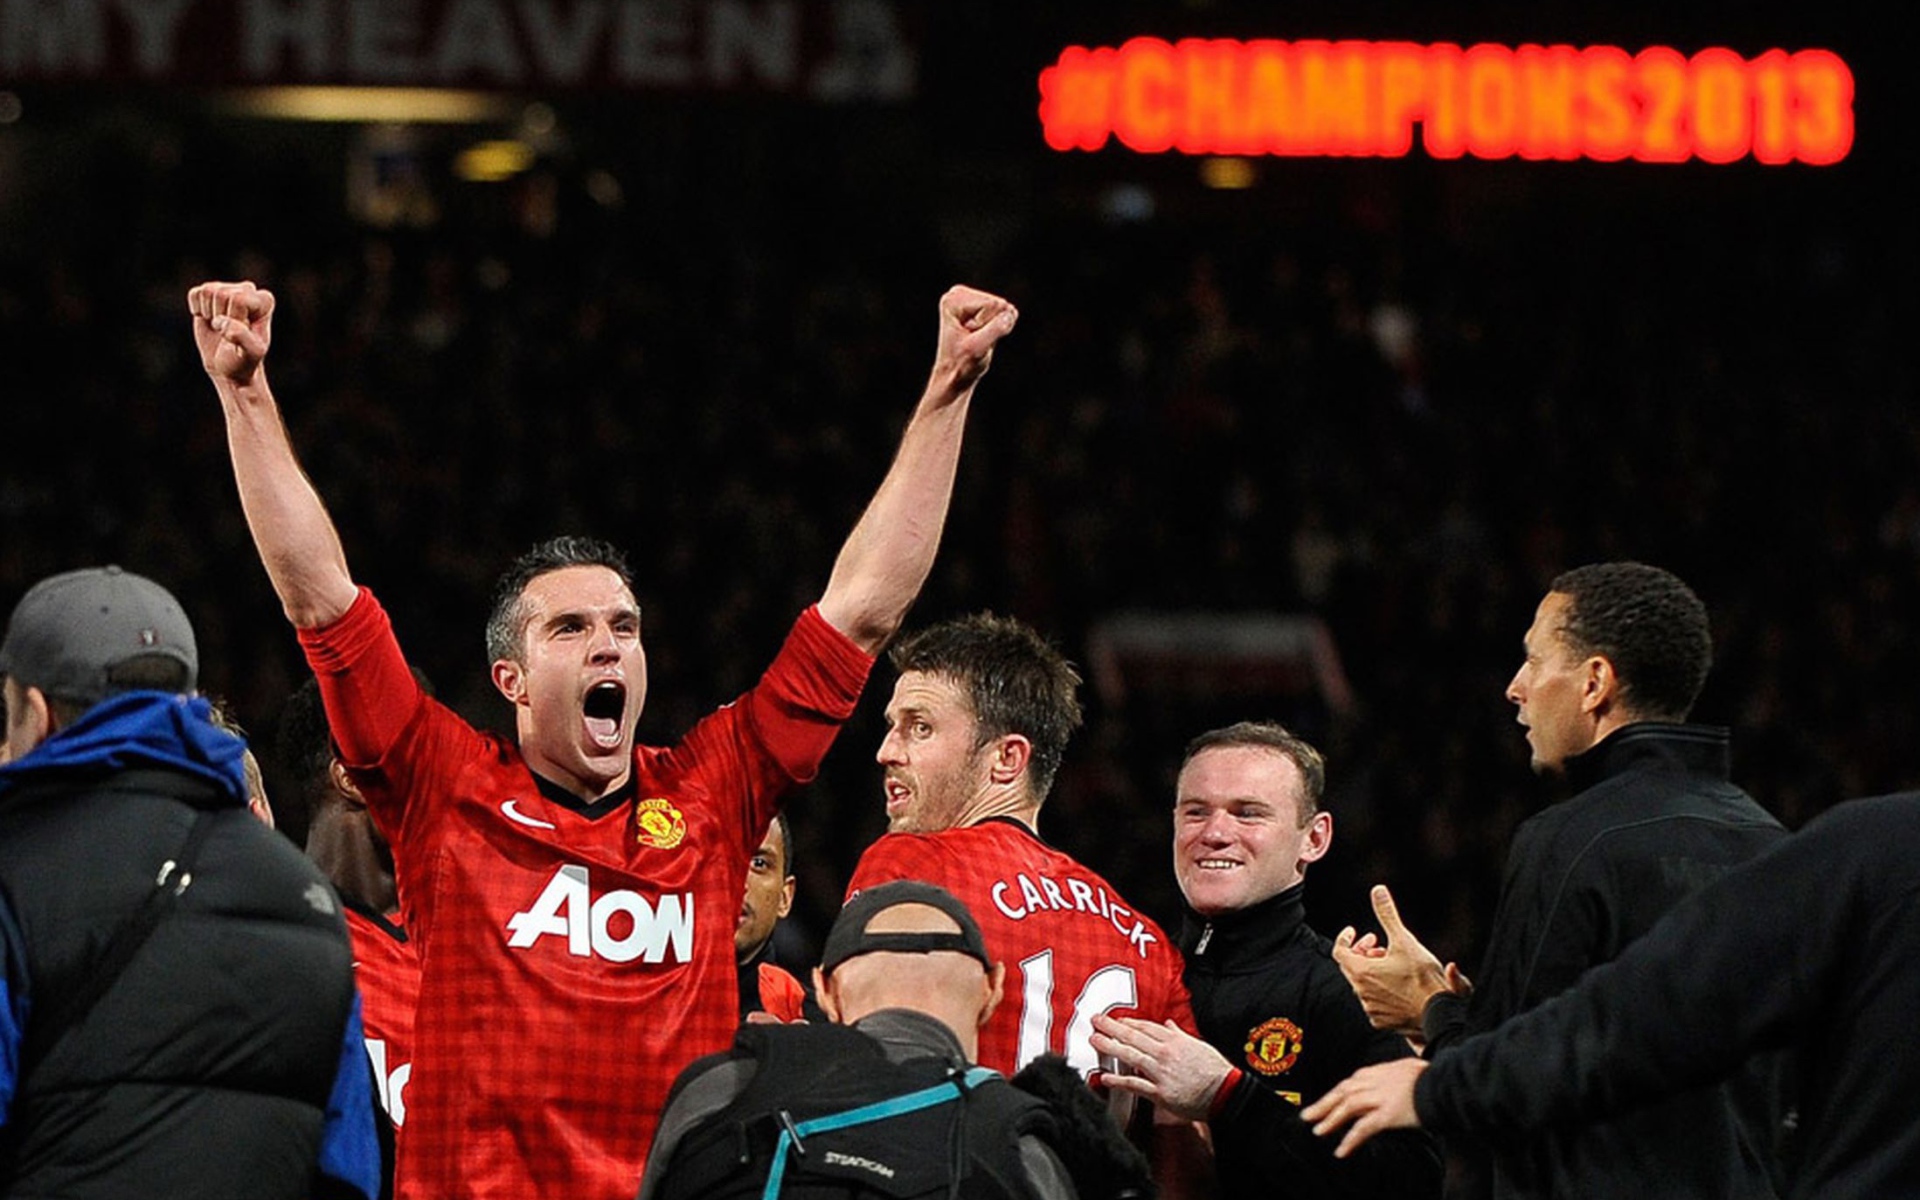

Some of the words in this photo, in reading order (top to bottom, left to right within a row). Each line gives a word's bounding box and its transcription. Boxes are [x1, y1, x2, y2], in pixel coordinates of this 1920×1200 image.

[0, 0, 188, 77] MY
[240, 0, 798, 86] HEAVEN
[1039, 37, 1855, 164] #CHAMPIONS2013
[991, 873, 1157, 959] CARRICK
[1016, 948, 1138, 1130] 16
